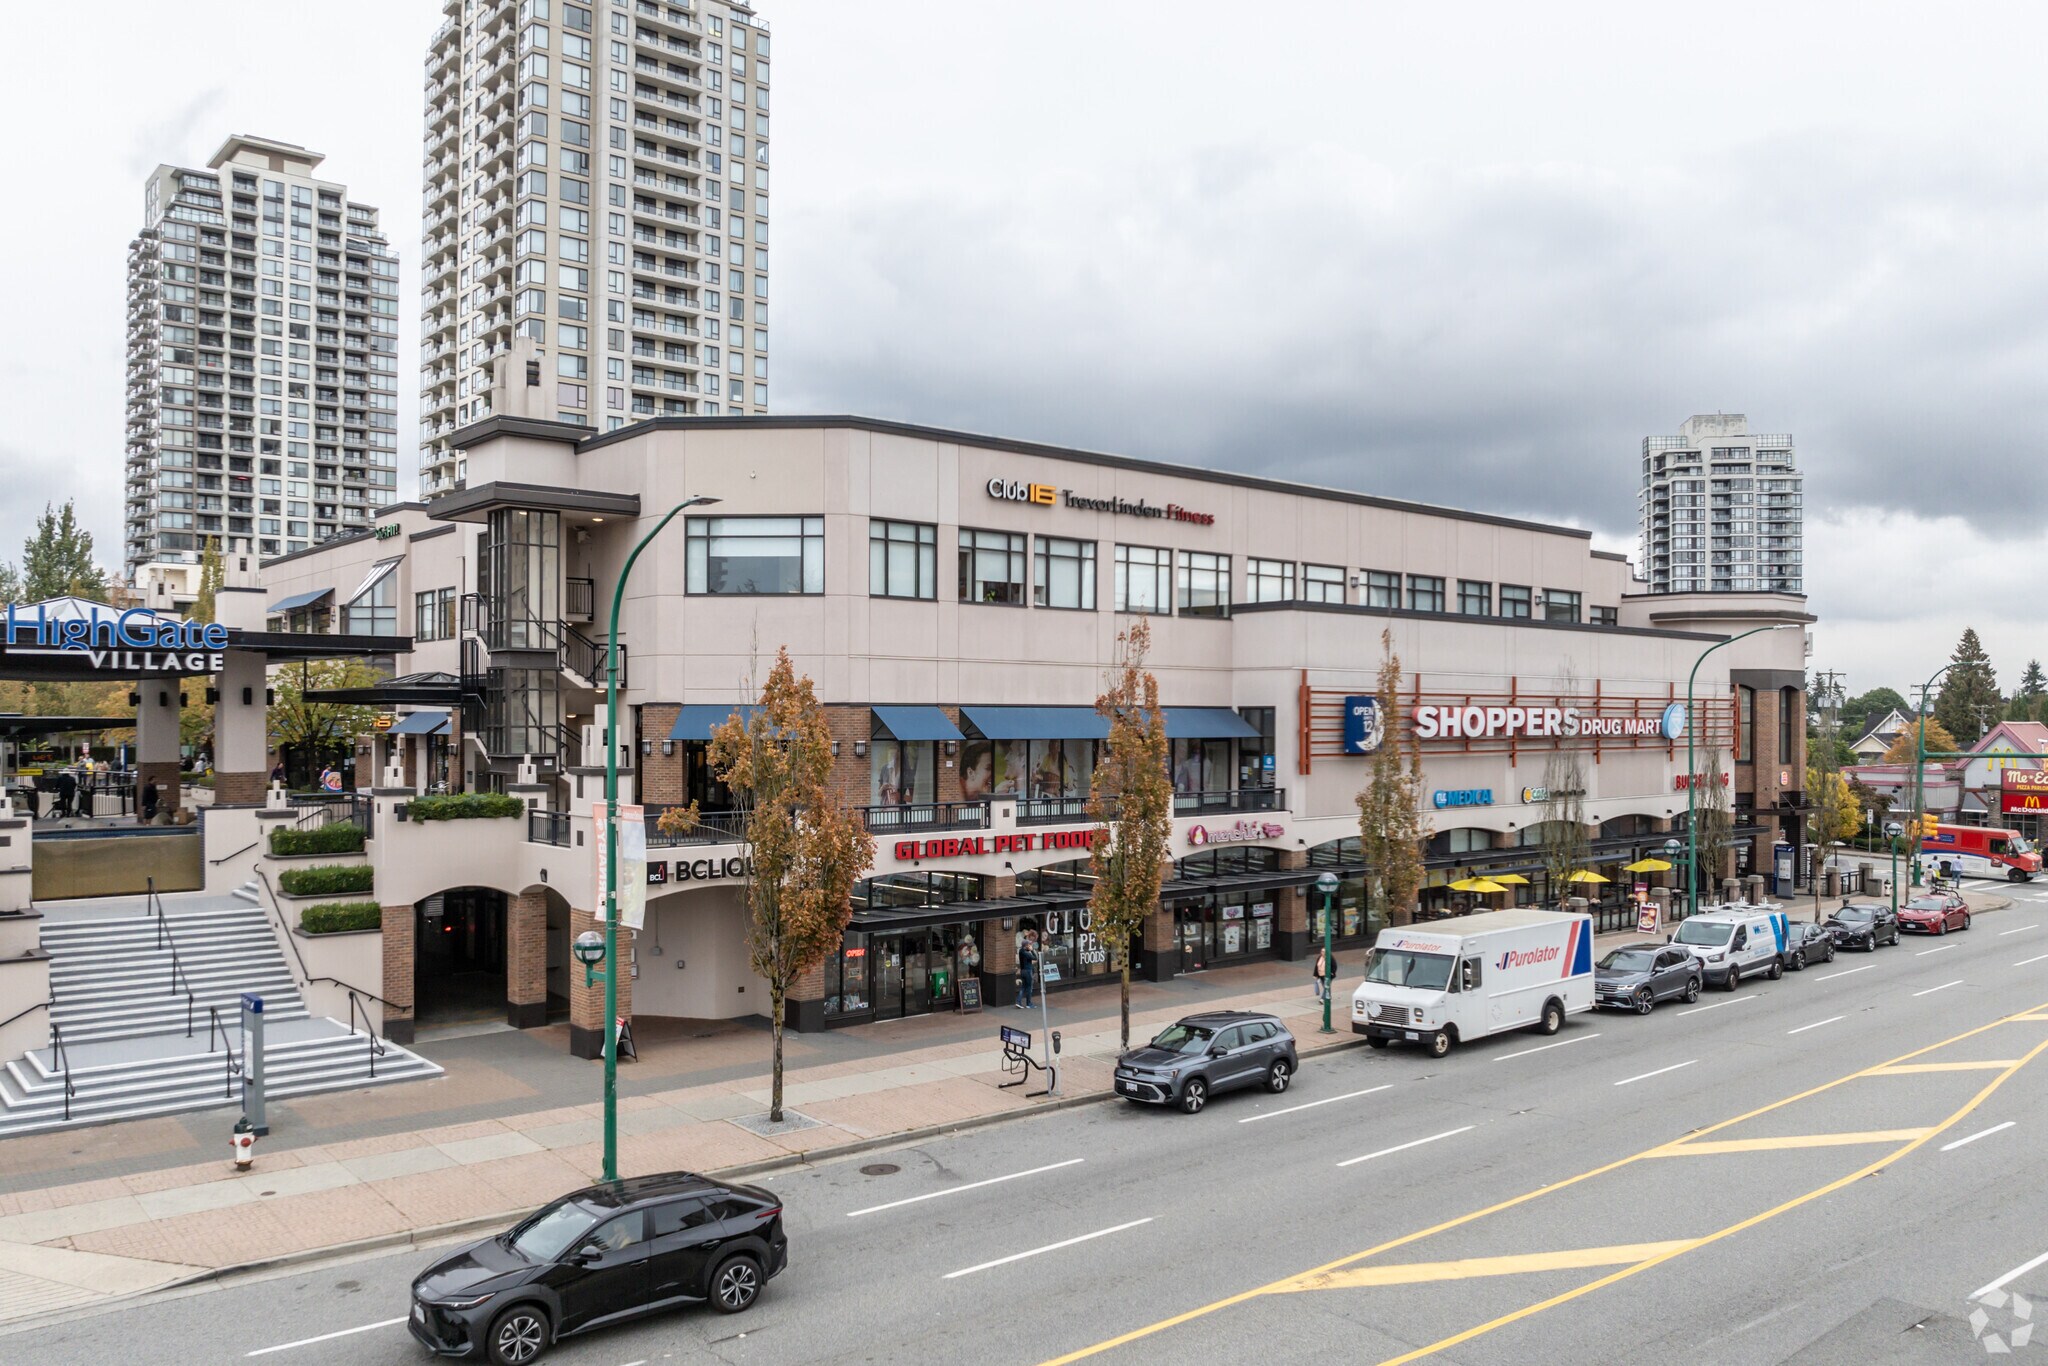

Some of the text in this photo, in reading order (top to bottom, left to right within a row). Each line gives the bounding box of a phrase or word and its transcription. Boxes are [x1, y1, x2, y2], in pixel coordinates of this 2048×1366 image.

[1167, 504, 1214, 525] Fitness
[7, 602, 229, 651] HighGate
[88, 651, 224, 671] VILLAGE
[1353, 706, 1374, 716] OPEN
[1363, 720, 1373, 732] 12
[1413, 705, 1662, 738] SHOPPERS DRUG MART
[1448, 789, 1494, 806] MEDICAL
[895, 837, 989, 860] GLOBAL
[994, 833, 1036, 853] PET
[649, 873, 663, 882] BCL
[1401, 940, 1442, 952] Purolator
[1080, 951, 1106, 965] FOODS
[1507, 946, 1560, 969] Purolator
